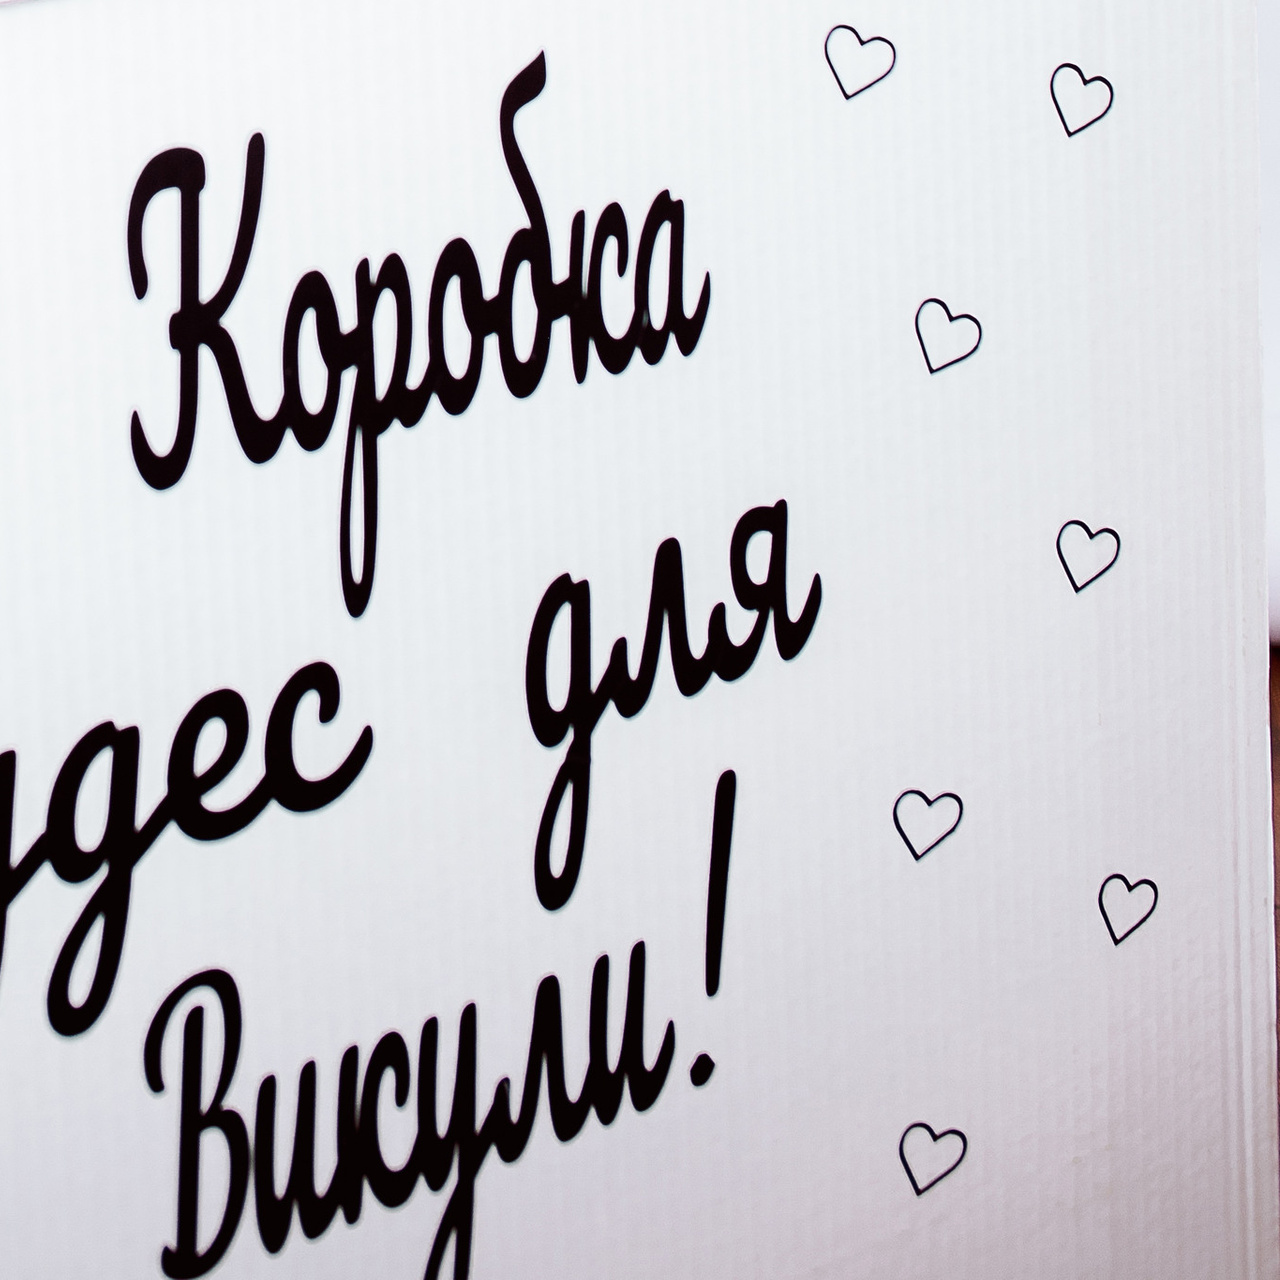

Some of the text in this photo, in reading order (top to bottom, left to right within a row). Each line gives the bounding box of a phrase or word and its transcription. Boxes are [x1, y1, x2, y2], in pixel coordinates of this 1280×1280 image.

[127, 49, 712, 619] Коробка
[525, 498, 823, 912] для
[143, 769, 737, 1280] Викули!
